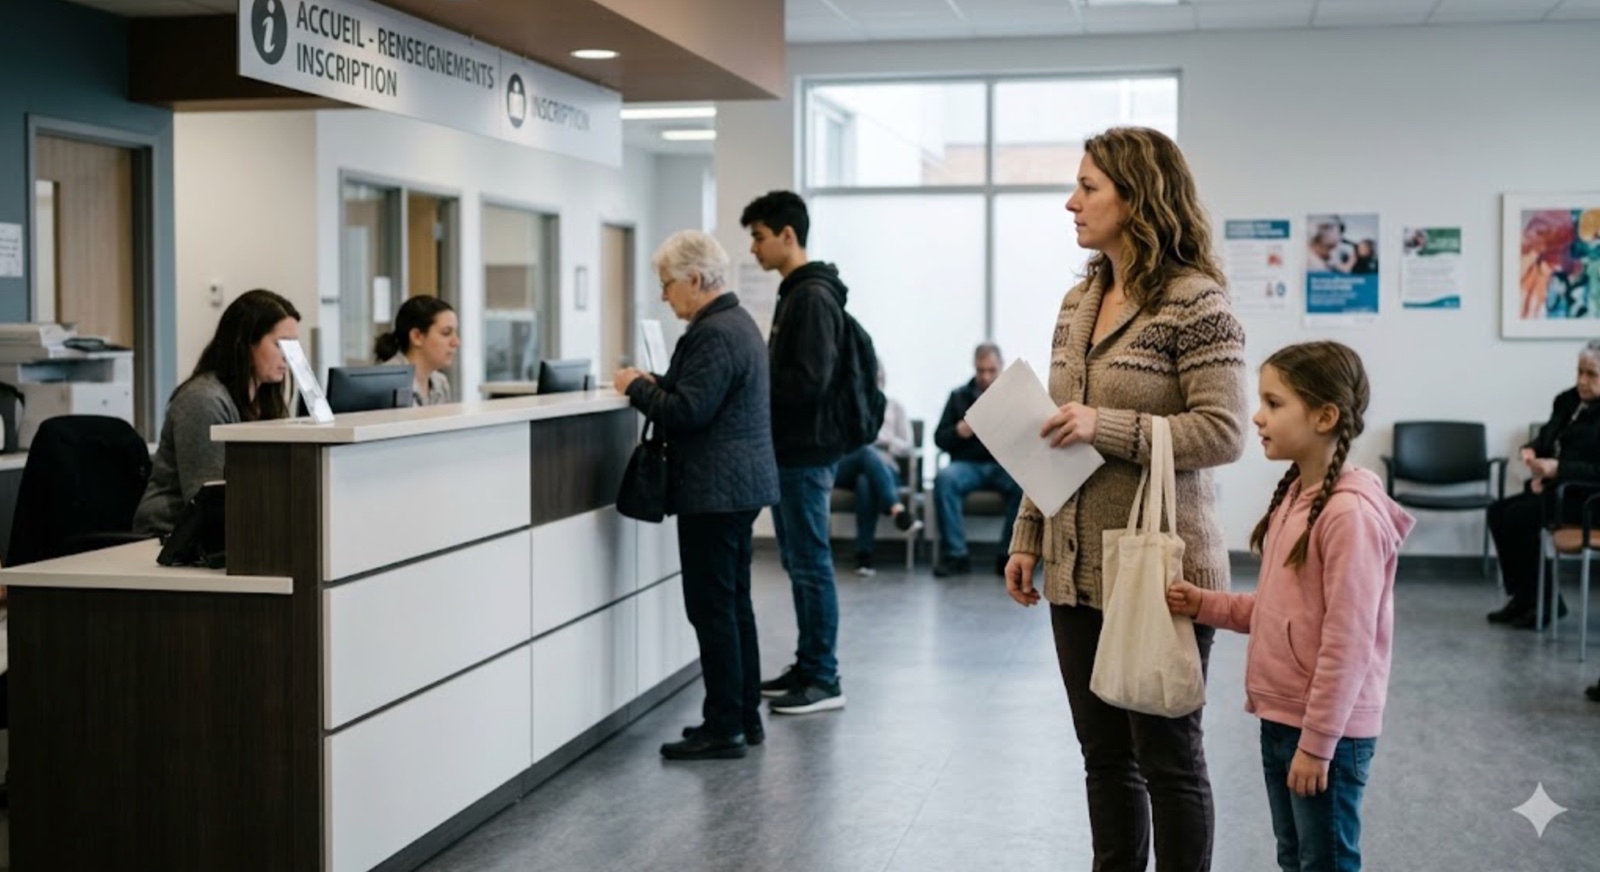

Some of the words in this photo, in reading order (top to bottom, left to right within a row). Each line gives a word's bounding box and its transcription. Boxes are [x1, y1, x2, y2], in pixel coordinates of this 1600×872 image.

[297, 0, 365, 48] ACCUEIL
[378, 27, 494, 90] RENSEIGNEMENTS
[297, 42, 397, 97] INSCRIPTION
[531, 95, 590, 132] INSCRIPTION
